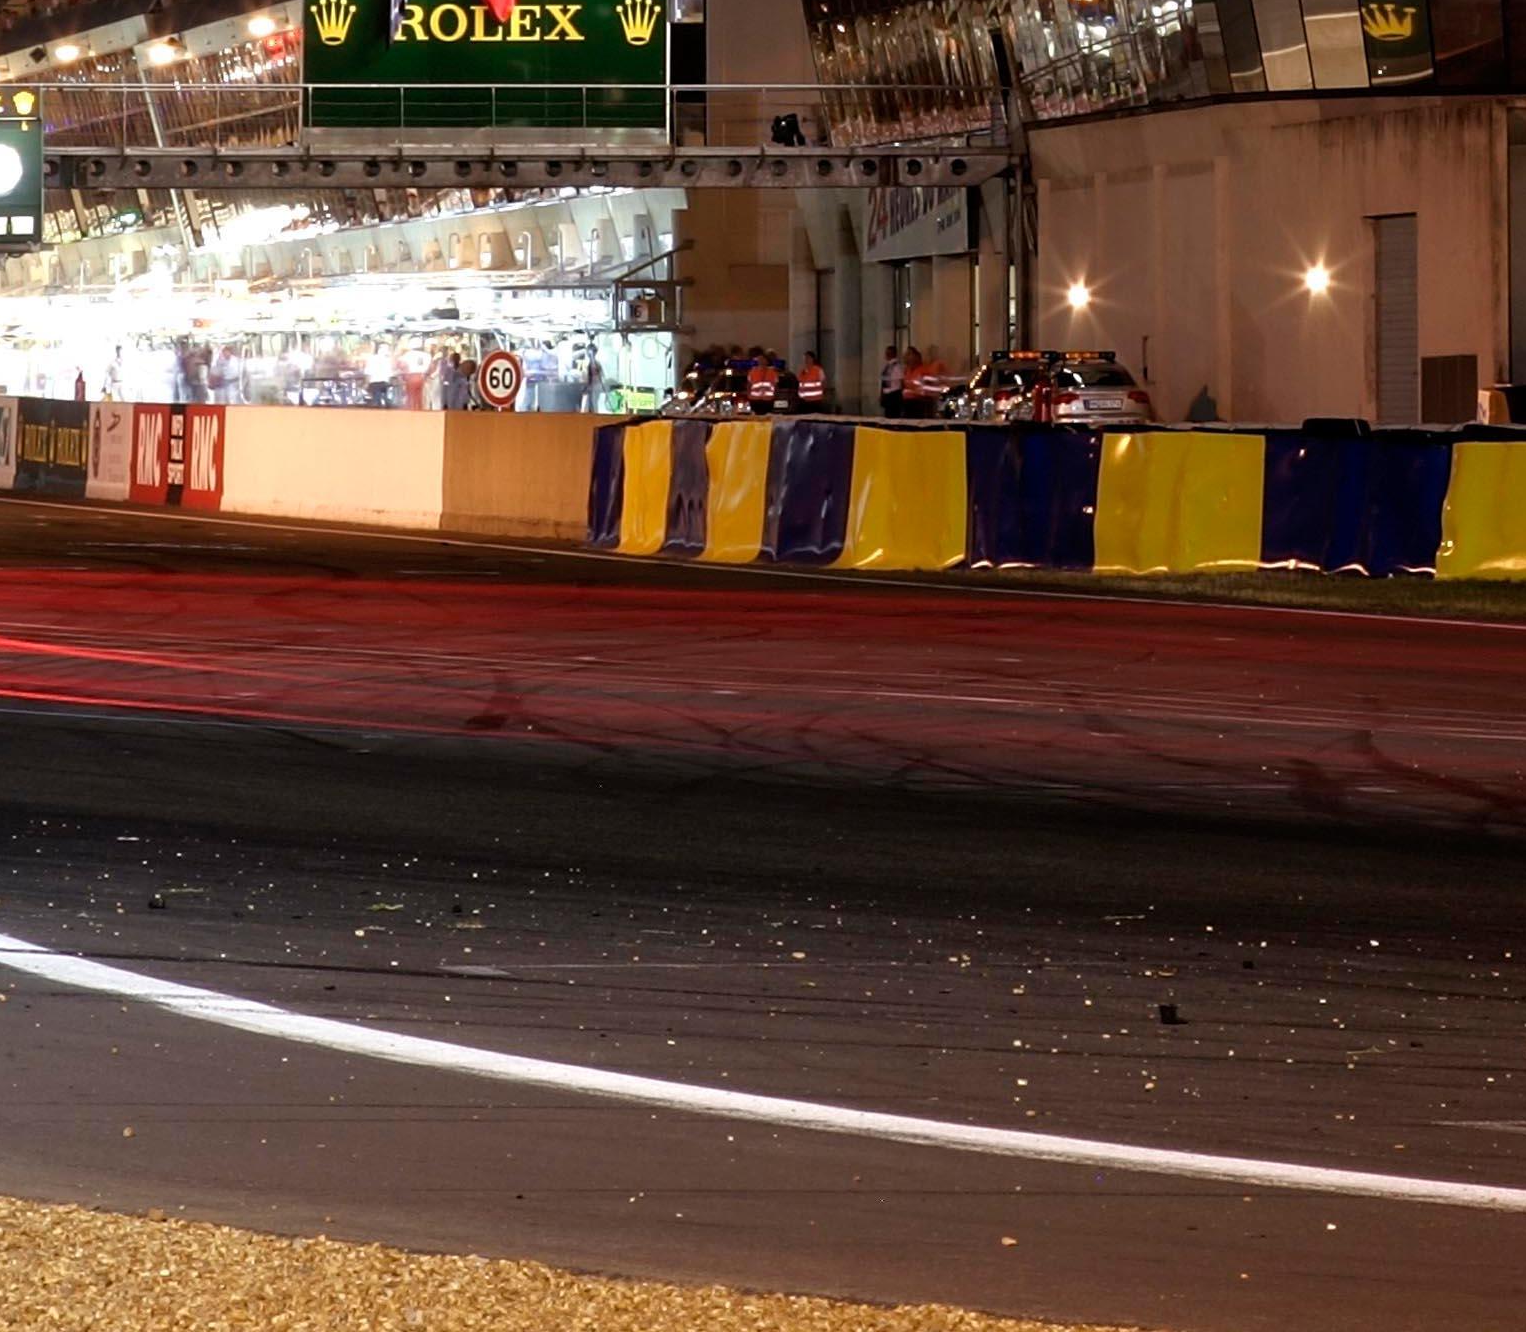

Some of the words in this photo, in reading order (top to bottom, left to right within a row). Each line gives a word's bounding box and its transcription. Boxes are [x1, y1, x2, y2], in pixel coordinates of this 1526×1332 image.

[393, 3, 585, 42] ROLEX
[488, 367, 514, 390] 60
[191, 414, 218, 491] RMC
